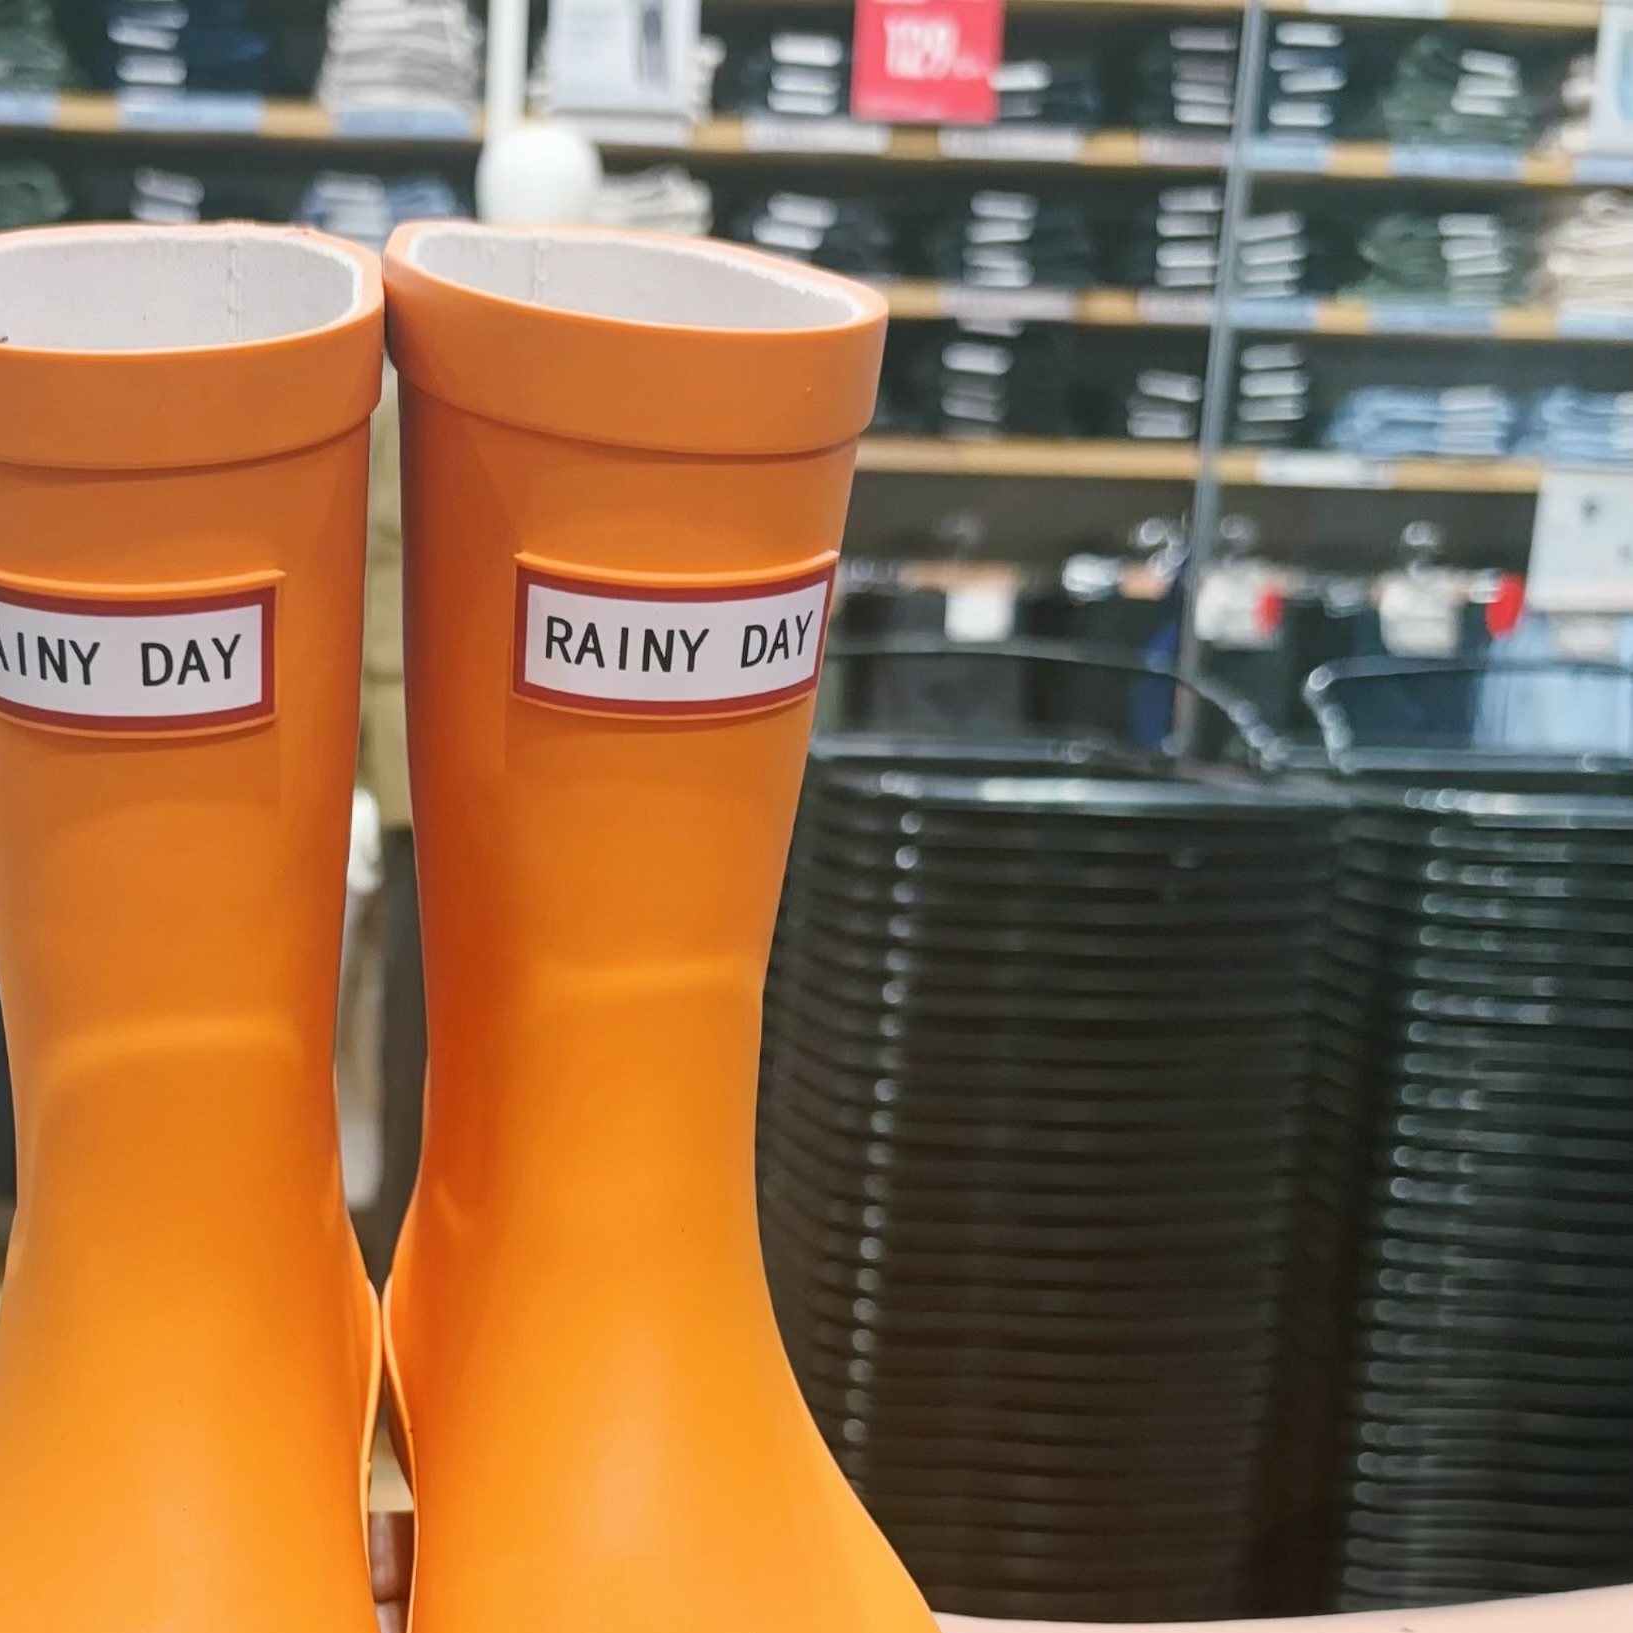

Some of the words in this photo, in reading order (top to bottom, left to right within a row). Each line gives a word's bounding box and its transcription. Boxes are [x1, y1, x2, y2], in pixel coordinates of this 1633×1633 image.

[139, 633, 242, 688] DAY
[544, 614, 711, 674] RAINY
[739, 609, 815, 670] DAY
